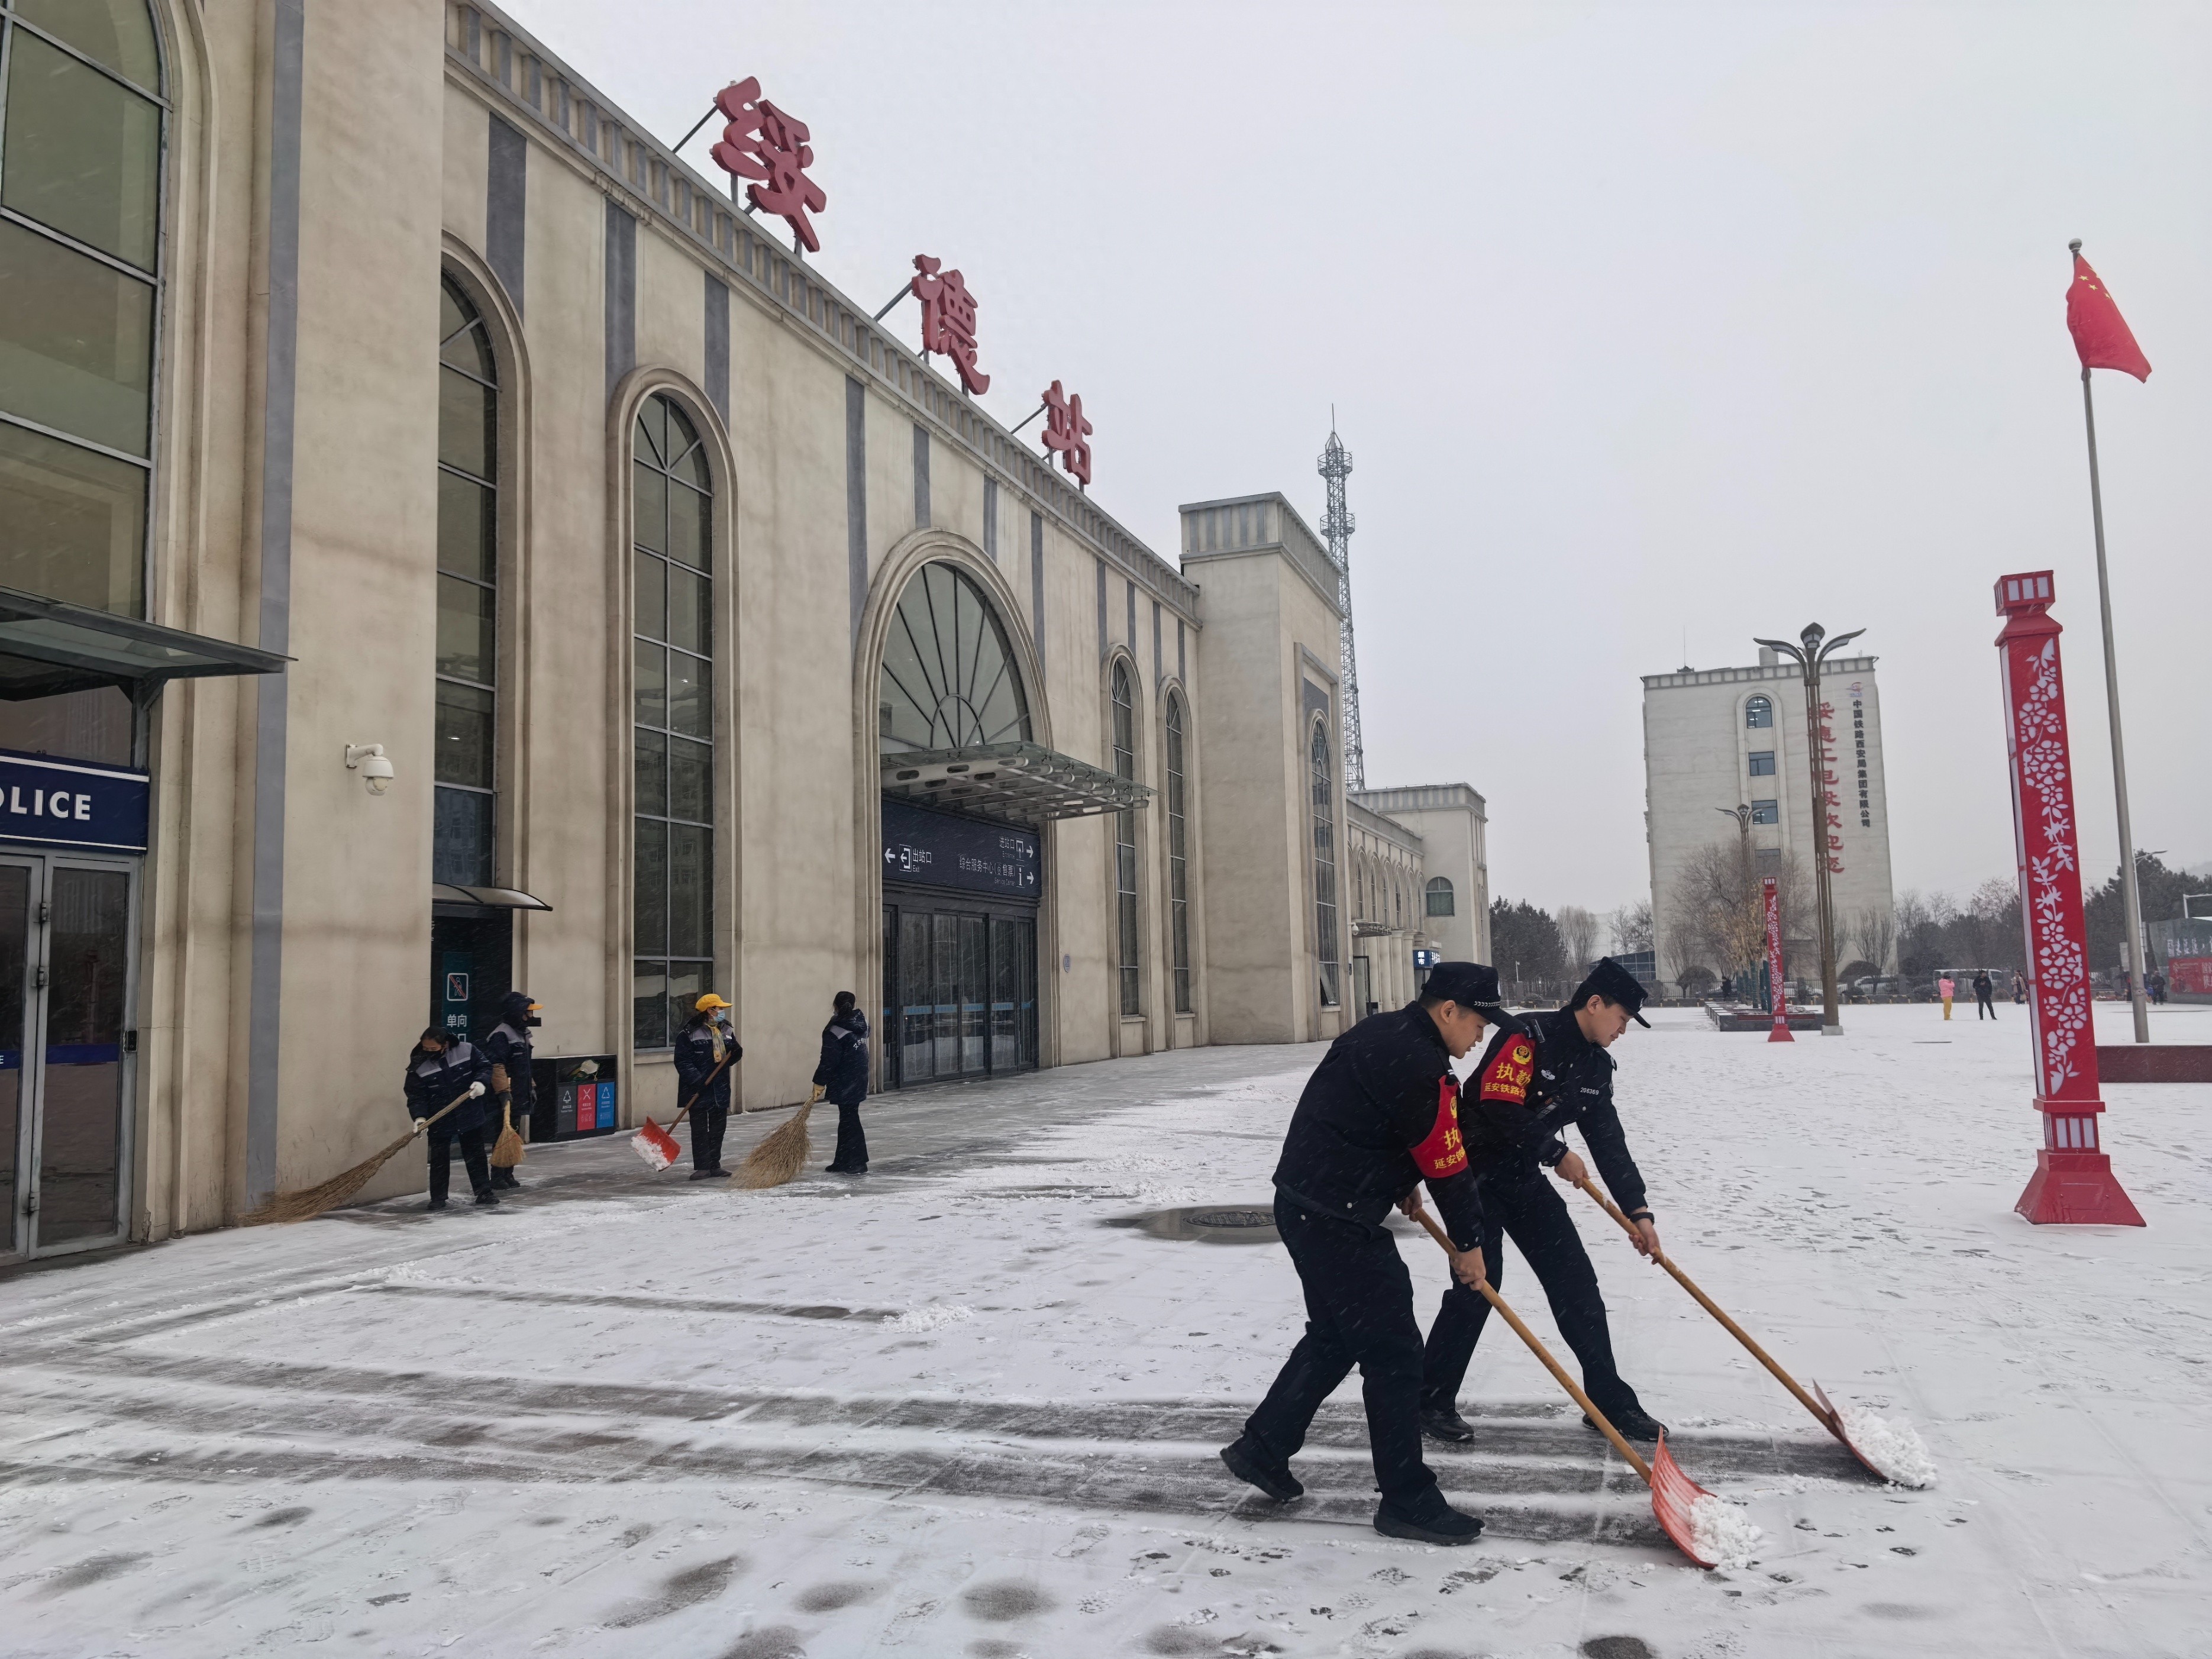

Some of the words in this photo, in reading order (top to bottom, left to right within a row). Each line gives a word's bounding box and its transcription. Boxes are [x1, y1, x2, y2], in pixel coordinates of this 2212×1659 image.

[1852, 699, 1871, 828] 中国铁路西安局集团有限公司
[999, 835, 1015, 850] 进站口
[912, 848, 932, 864] 出站口
[447, 1014, 467, 1028] 单向
[1496, 1062, 1532, 1087] 执勤
[1580, 1087, 1599, 1096] 206369
